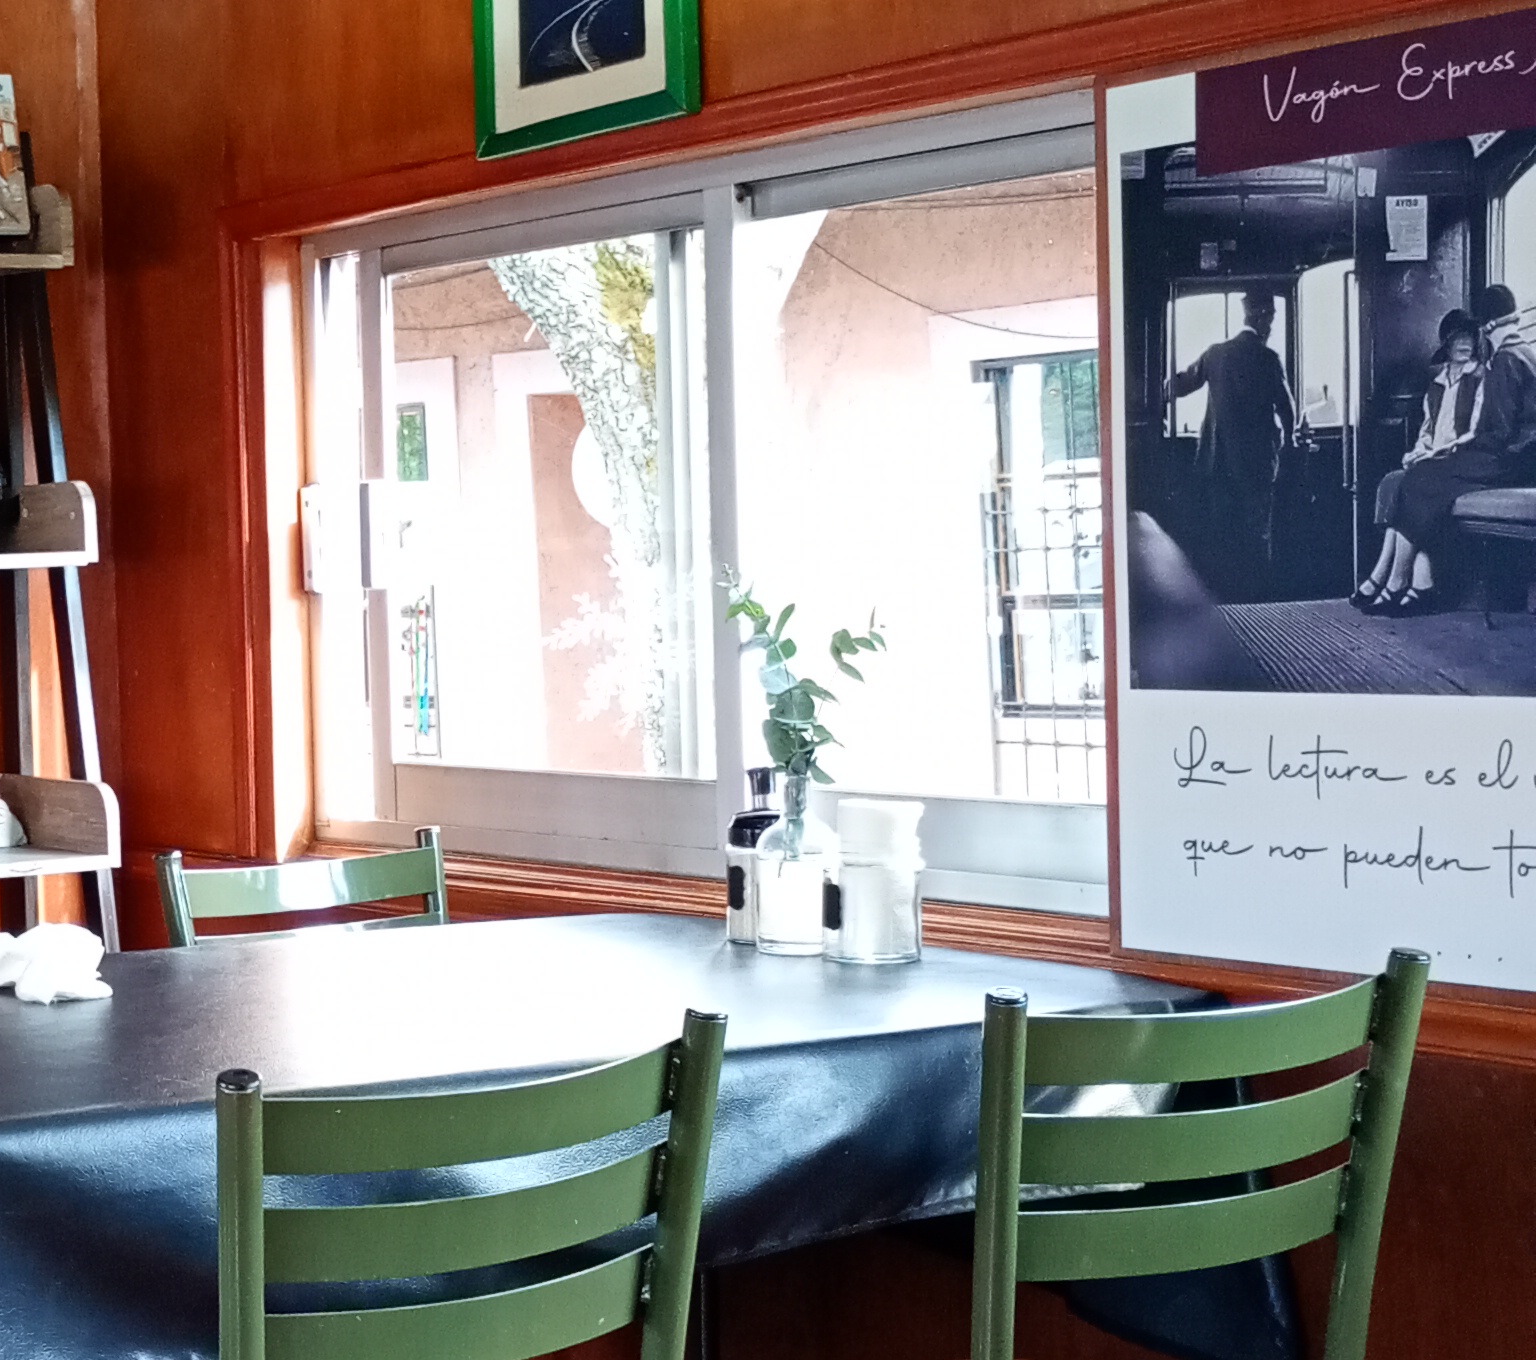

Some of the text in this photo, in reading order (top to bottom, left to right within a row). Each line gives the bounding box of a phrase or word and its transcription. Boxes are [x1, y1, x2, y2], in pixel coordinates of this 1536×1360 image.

[1263, 43, 1516, 123] Vagón Express
[1174, 726, 1519, 800] La lectura es el
[1183, 839, 1254, 877] que
[1268, 843, 1329, 861] no
[1343, 825, 1491, 889] pueden
